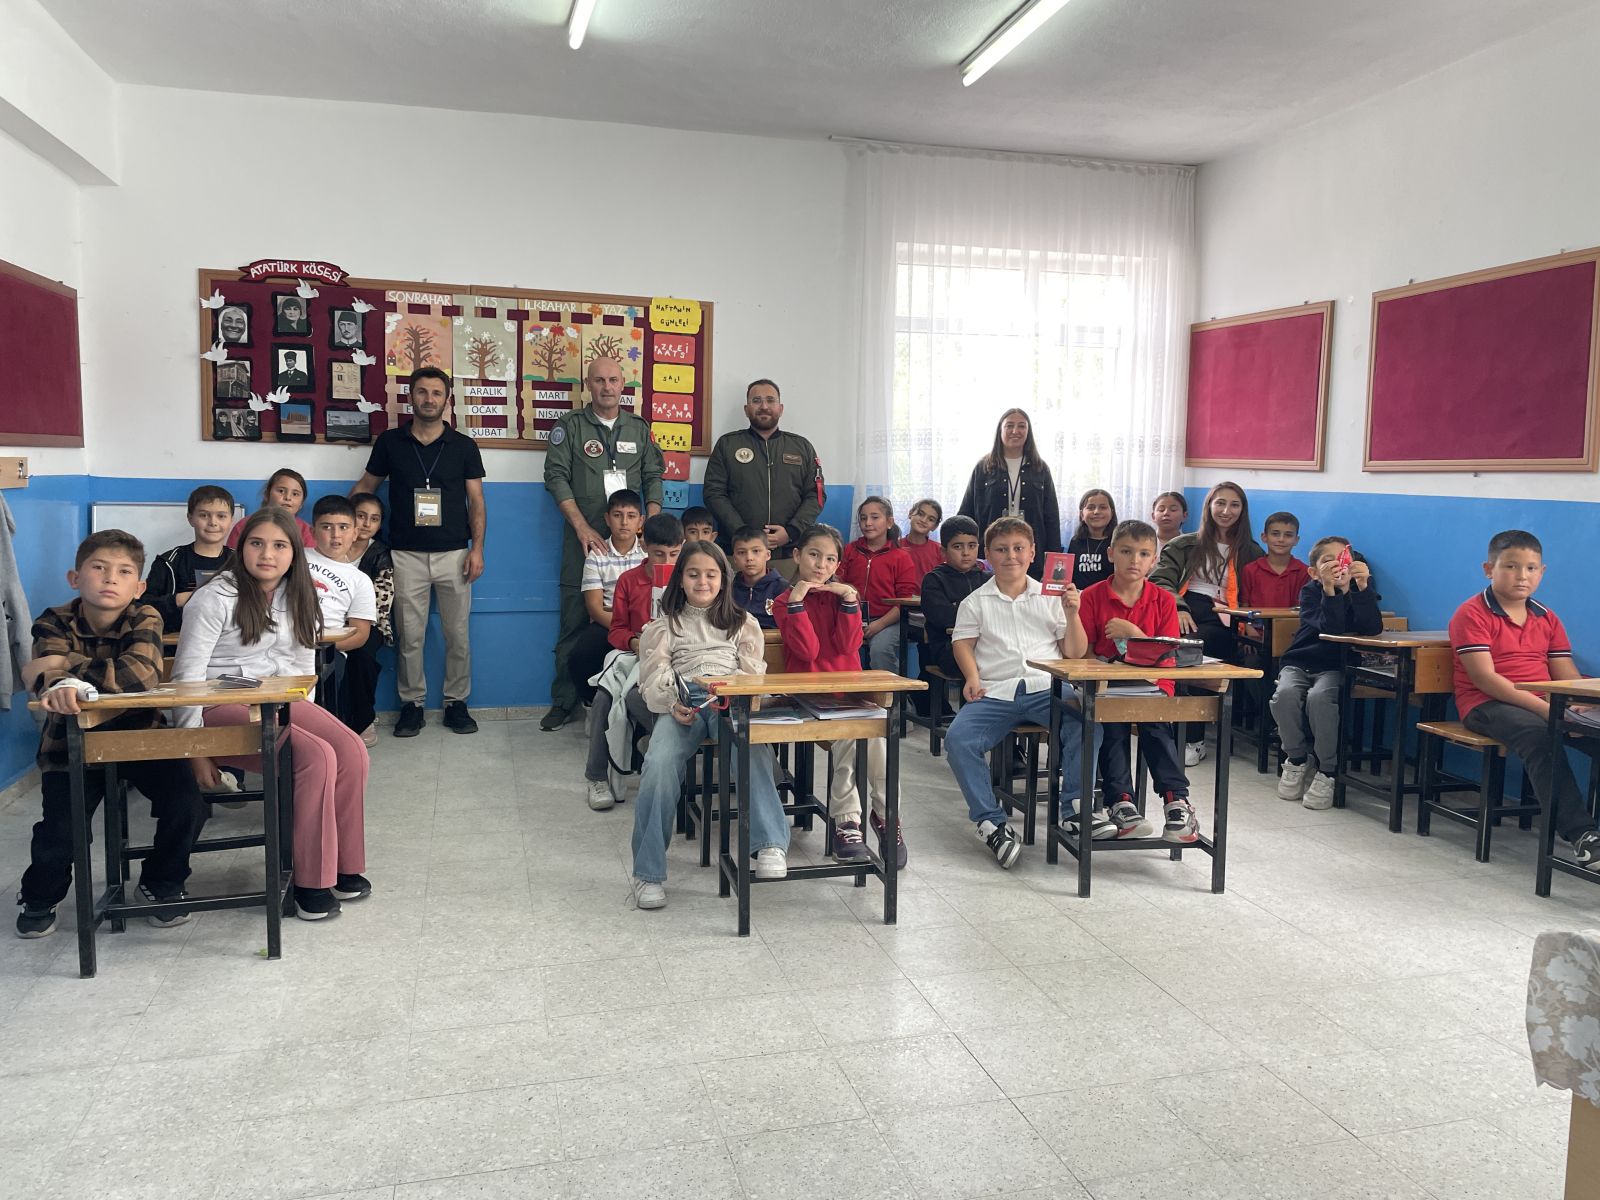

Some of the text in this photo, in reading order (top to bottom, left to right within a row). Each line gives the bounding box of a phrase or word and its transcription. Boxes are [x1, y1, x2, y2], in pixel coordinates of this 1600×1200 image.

[250, 261, 298, 278] ATATÜRK
[388, 290, 451, 305] SONBAHAR
[603, 304, 624, 315] YAZ
[469, 387, 503, 396] ARALIK
[538, 391, 565, 400] MART
[471, 405, 498, 414] OCAK
[472, 428, 502, 438] ŞUBAT
